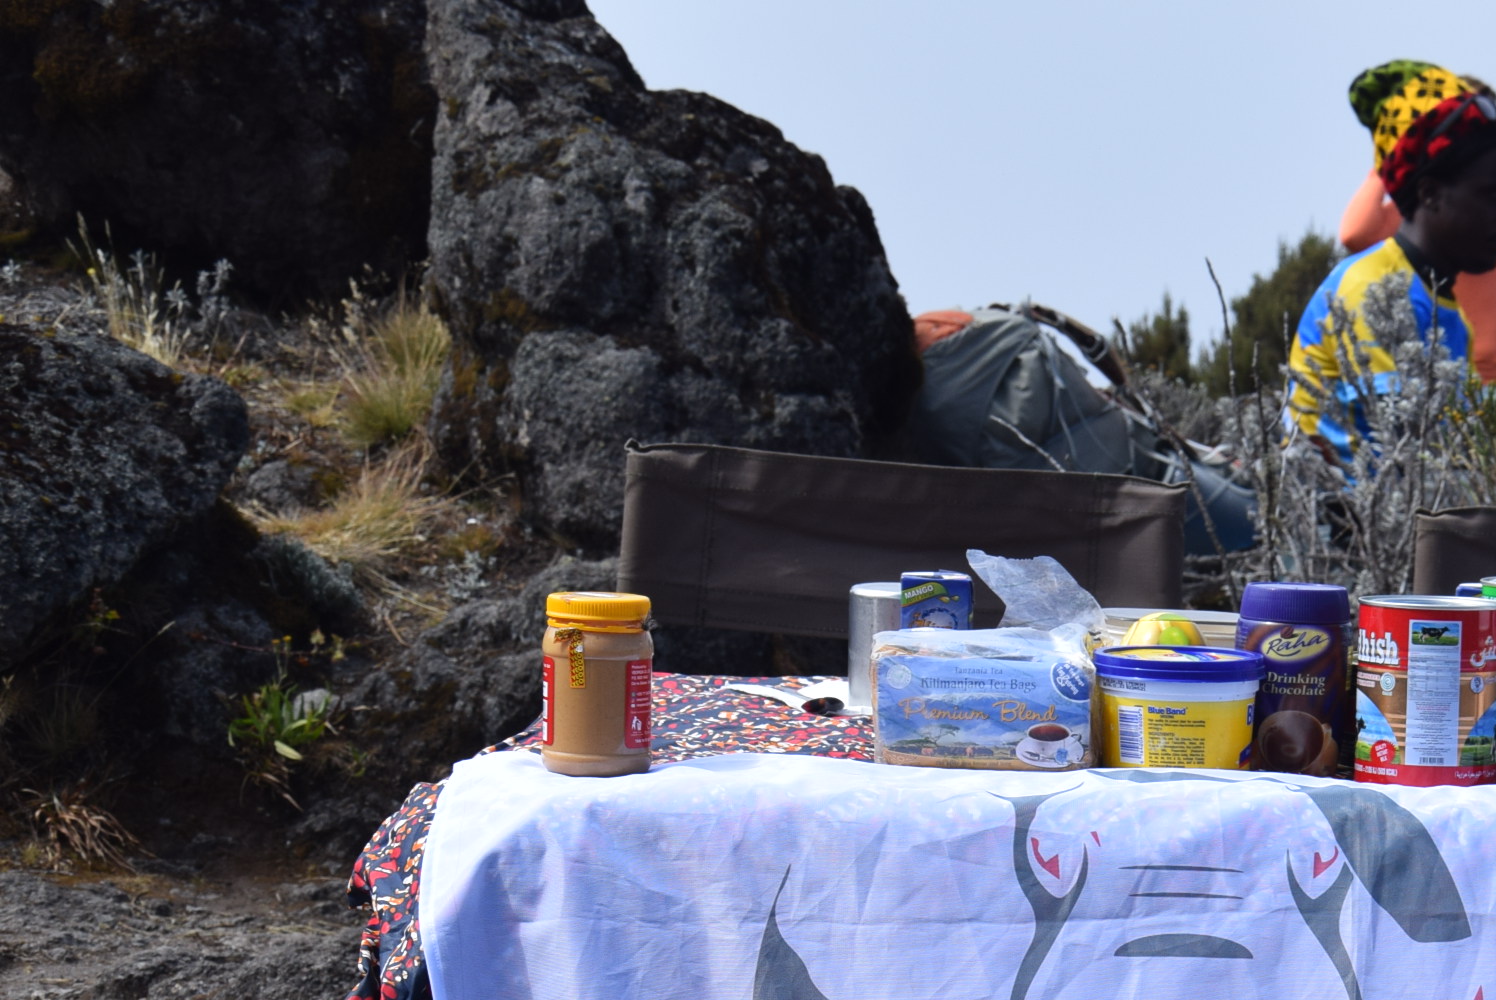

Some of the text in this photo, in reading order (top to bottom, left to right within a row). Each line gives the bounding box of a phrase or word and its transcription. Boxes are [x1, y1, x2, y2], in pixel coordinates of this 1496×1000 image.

[904, 584, 934, 599] MANGO
[1266, 632, 1328, 656] Raha
[1358, 629, 1399, 664] hish
[954, 666, 1003, 675] Tanzania Tea
[921, 677, 1037, 693] Kilimanjaro Tea Bags
[1267, 672, 1326, 687] Drinking
[1262, 682, 1326, 696] Chocolate
[898, 696, 1058, 722] Premium Blend
[1147, 706, 1186, 715] Blue Band
